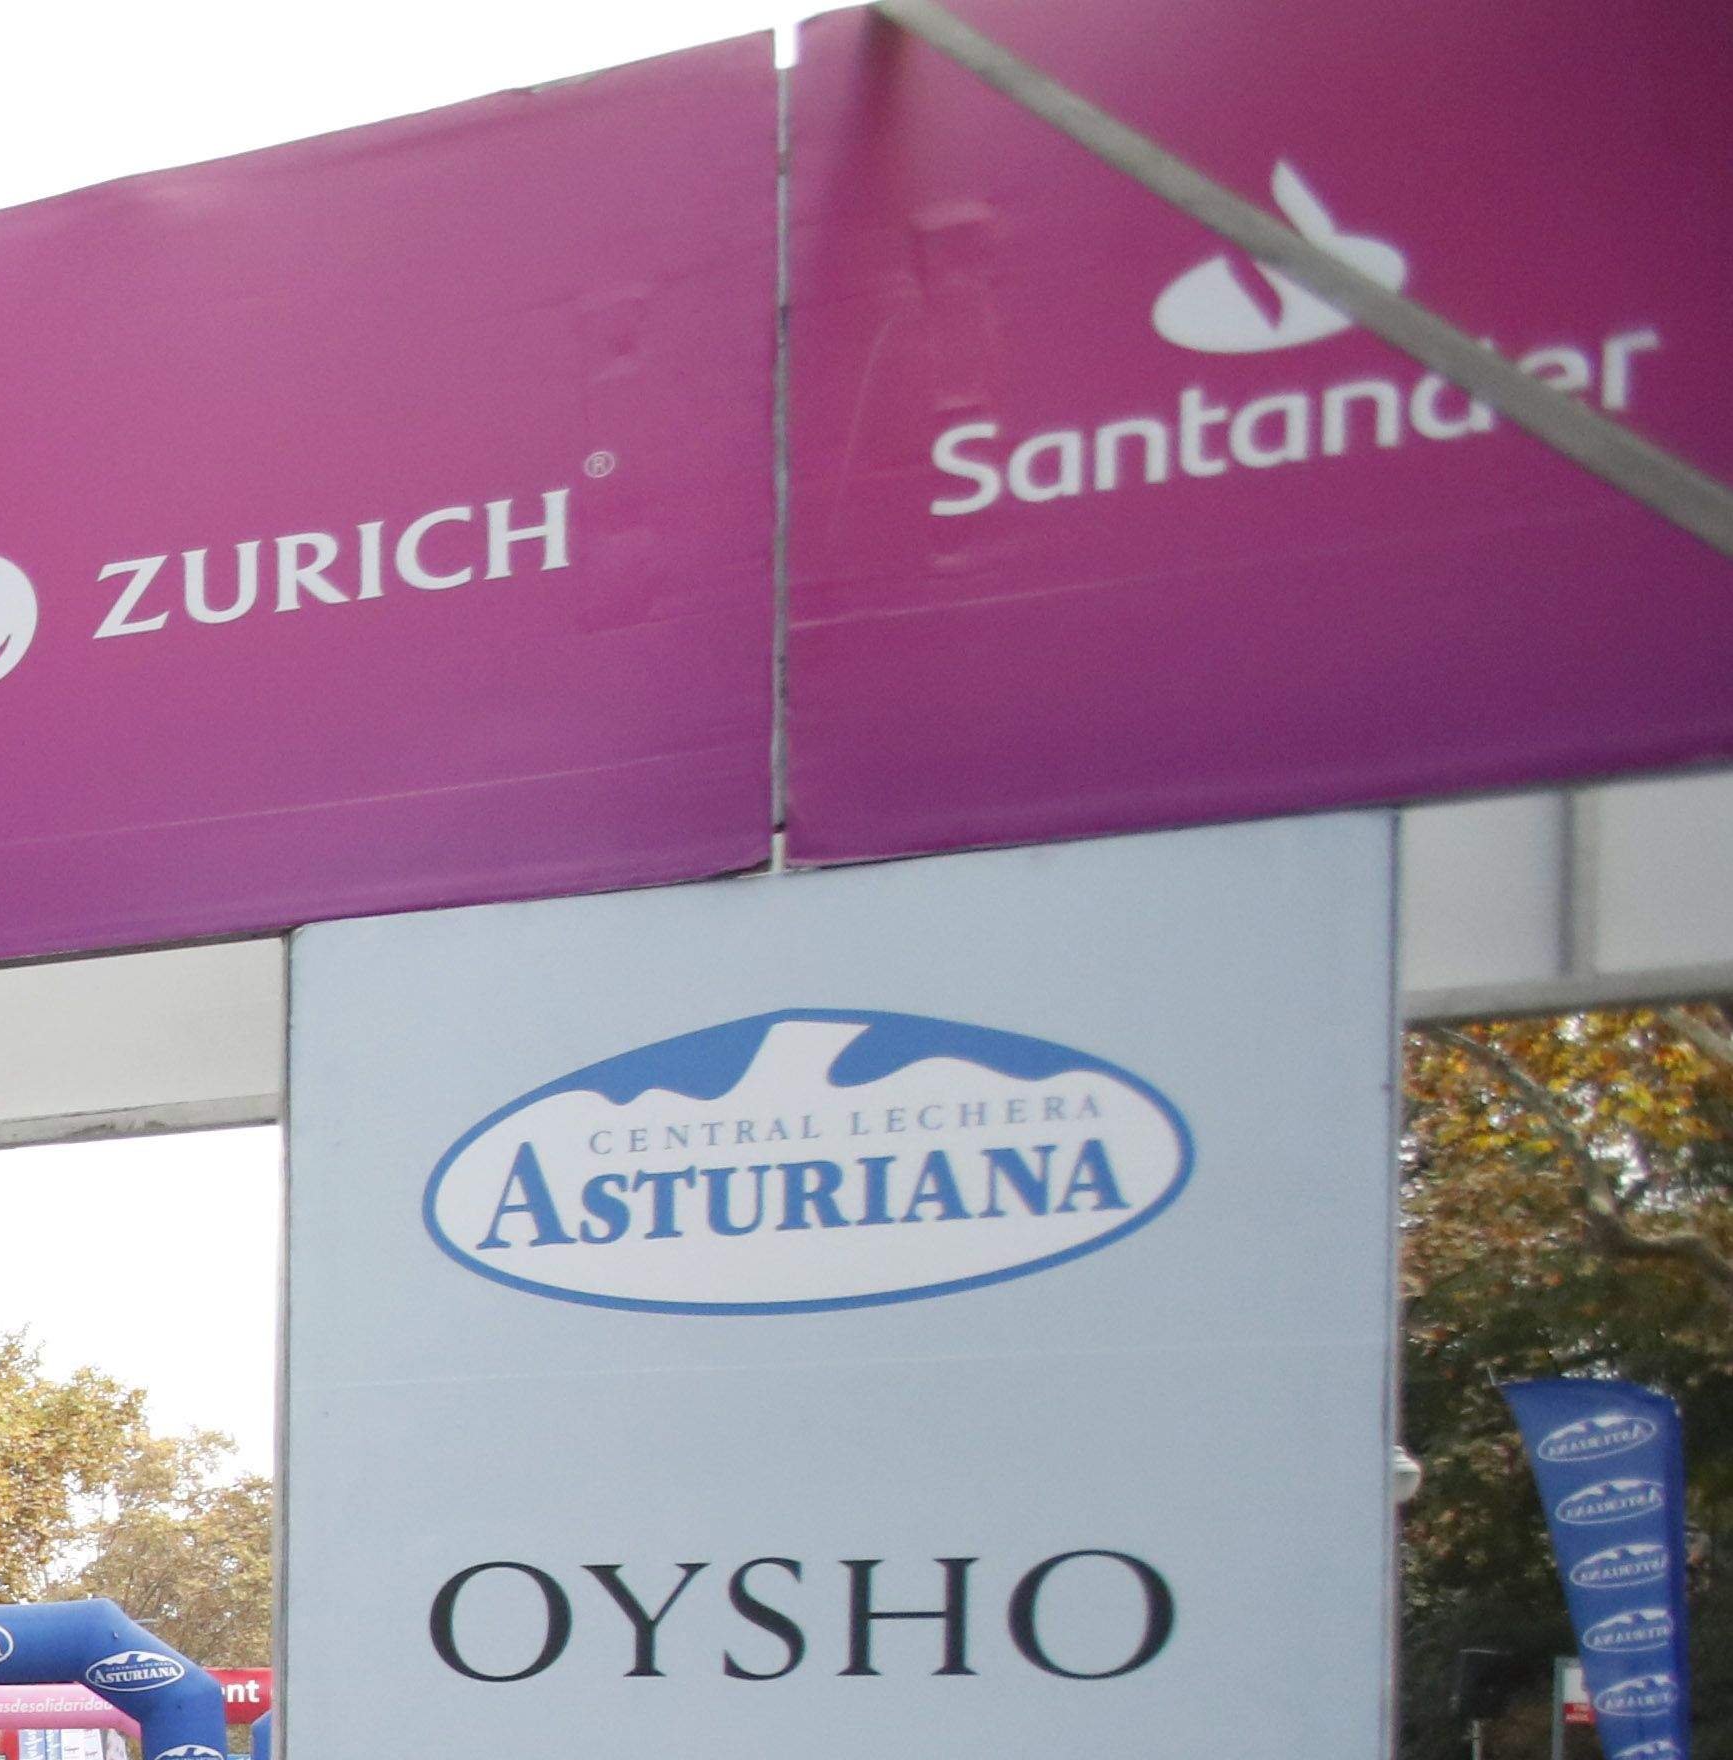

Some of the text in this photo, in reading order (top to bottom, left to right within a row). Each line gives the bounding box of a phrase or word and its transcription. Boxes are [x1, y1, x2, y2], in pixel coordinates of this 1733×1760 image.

[92, 488, 573, 640] ZURICH
[589, 1093, 1103, 1156] CENTRAL LECHERA
[475, 1137, 1134, 1252] ASTURIANA
[427, 1548, 1177, 1684] OYSHO
[95, 1666, 179, 1683] ASTURIANA
